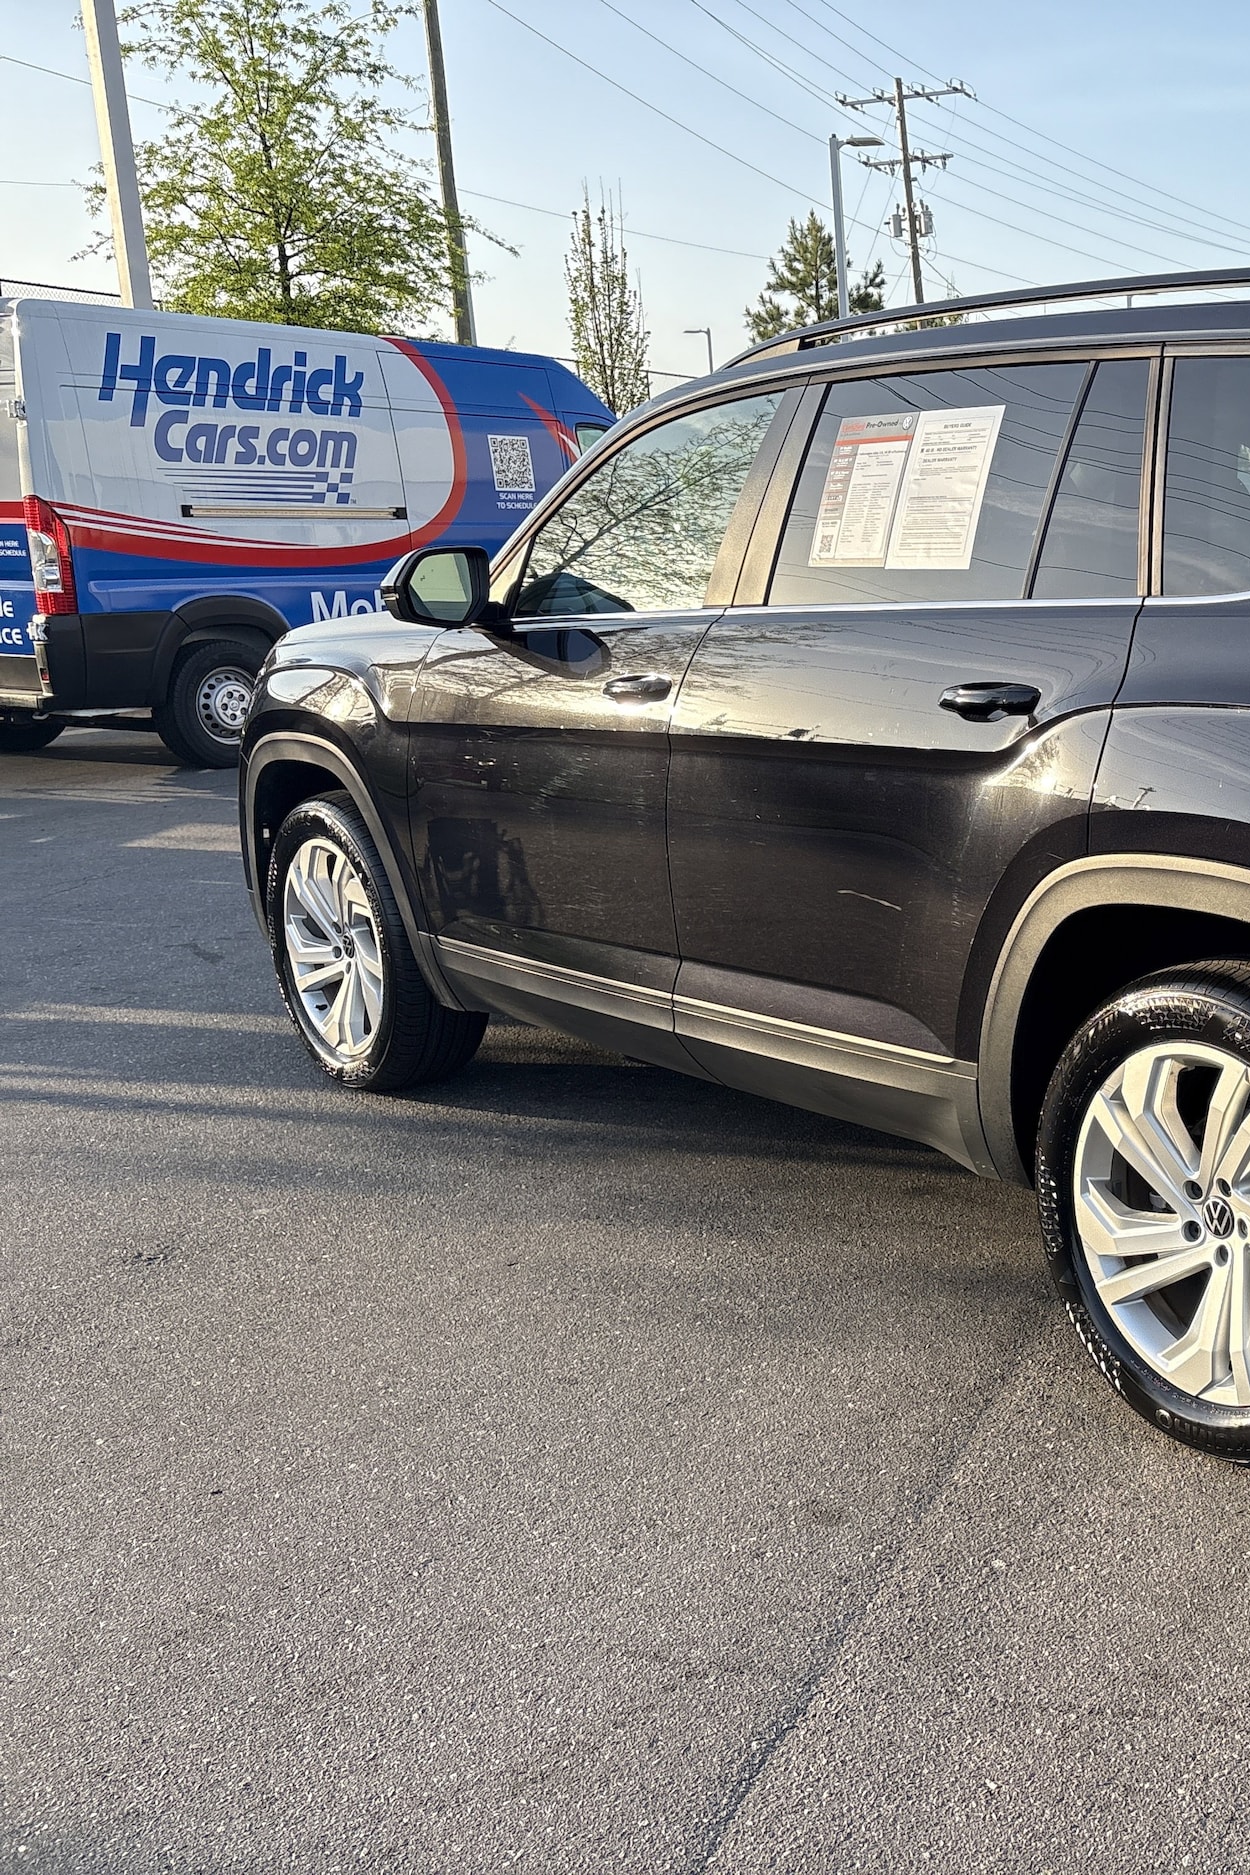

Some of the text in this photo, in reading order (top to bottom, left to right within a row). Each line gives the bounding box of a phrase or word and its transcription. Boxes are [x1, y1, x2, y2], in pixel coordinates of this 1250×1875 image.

[98, 332, 364, 427] Hendrick
[154, 409, 357, 469] Cars.com
[496, 501, 506, 509] TO
[499, 492, 534, 500] SCAN HERE
